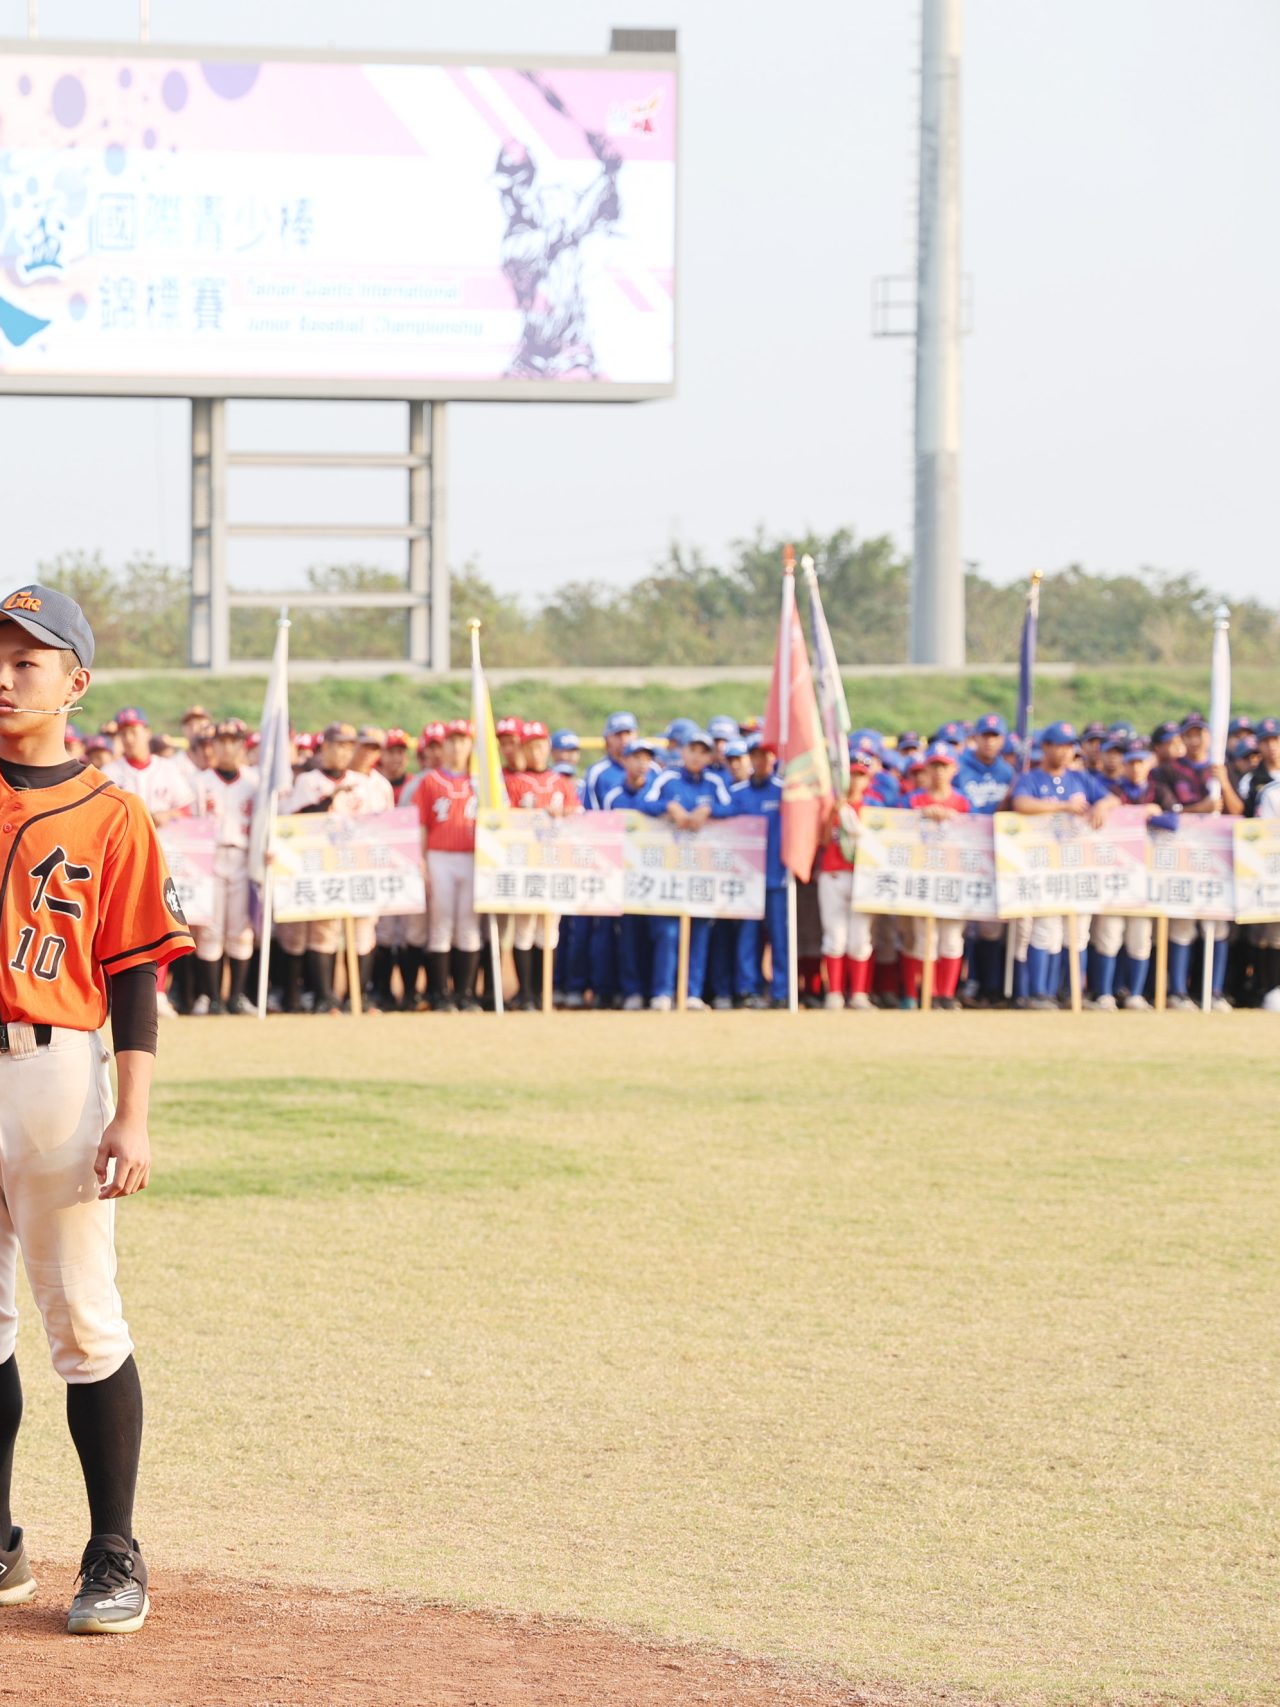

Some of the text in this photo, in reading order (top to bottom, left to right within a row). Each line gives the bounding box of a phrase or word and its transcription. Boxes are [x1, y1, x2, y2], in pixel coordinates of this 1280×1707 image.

[96, 192, 316, 252] 國際青少棒
[98, 275, 225, 332] 錦標賽
[294, 874, 404, 905] 長安國中
[495, 873, 605, 900] 重慶國中
[624, 871, 746, 903] 汐止國中
[1017, 870, 1128, 901] 新明國中
[9, 926, 66, 981] 10
